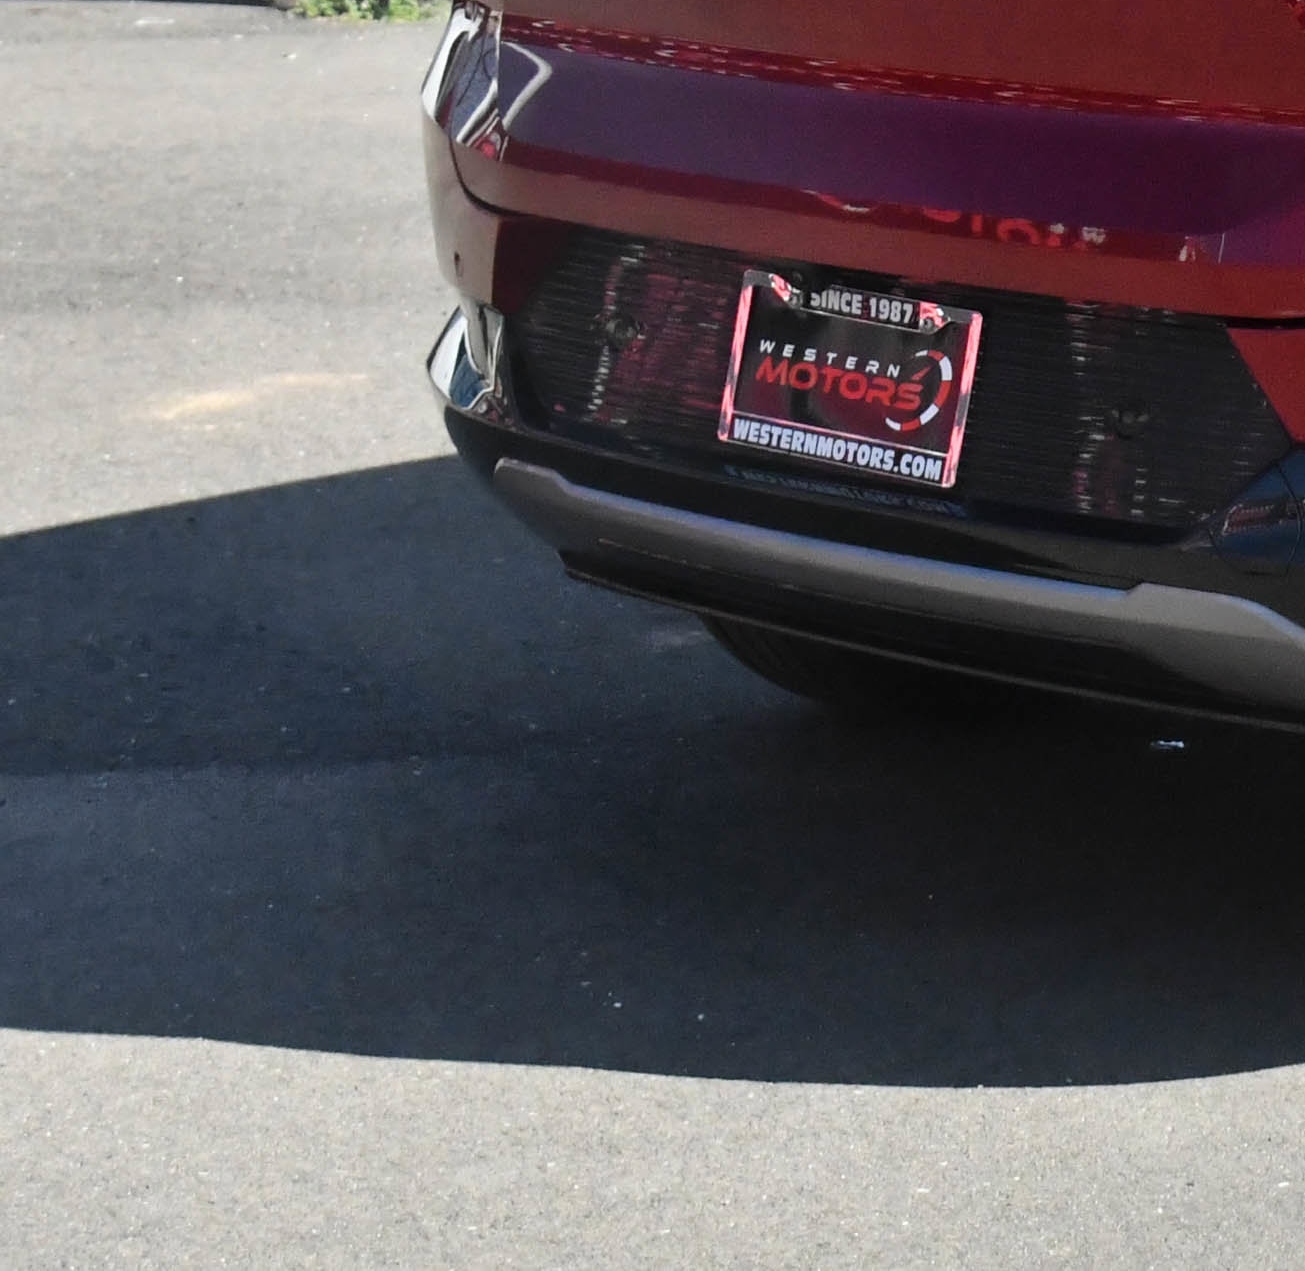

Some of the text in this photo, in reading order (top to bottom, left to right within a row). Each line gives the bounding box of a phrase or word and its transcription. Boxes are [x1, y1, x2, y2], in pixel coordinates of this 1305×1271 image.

[810, 289, 914, 324] SINCE 1987
[759, 339, 901, 378] WESTERN
[754, 356, 924, 411] MOTORS
[733, 419, 943, 481] WESTERNMOTORS.COM
